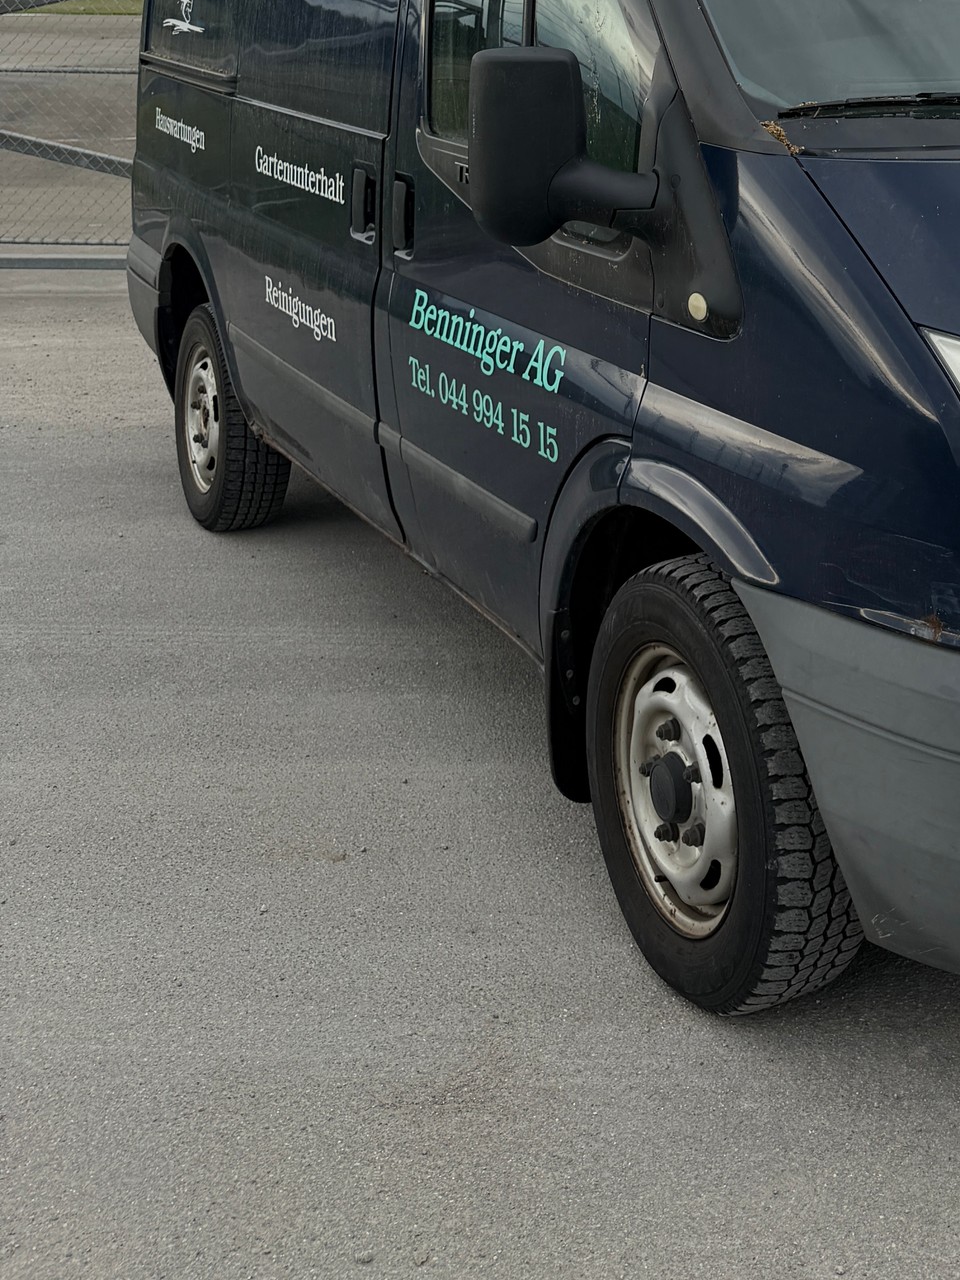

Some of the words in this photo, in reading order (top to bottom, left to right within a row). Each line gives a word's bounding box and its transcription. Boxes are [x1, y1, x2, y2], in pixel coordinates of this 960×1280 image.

[155, 106, 205, 154] Hauswartungen
[255, 145, 345, 205] Gartenunterhalt
[264, 275, 337, 342] Reinigungen
[408, 288, 524, 376] Benninger
[522, 339, 567, 394] AG
[408, 356, 435, 398] Tel.
[438, 372, 468, 416] 044
[472, 389, 505, 435] 994
[511, 408, 531, 448] 15
[537, 421, 559, 463] 15
